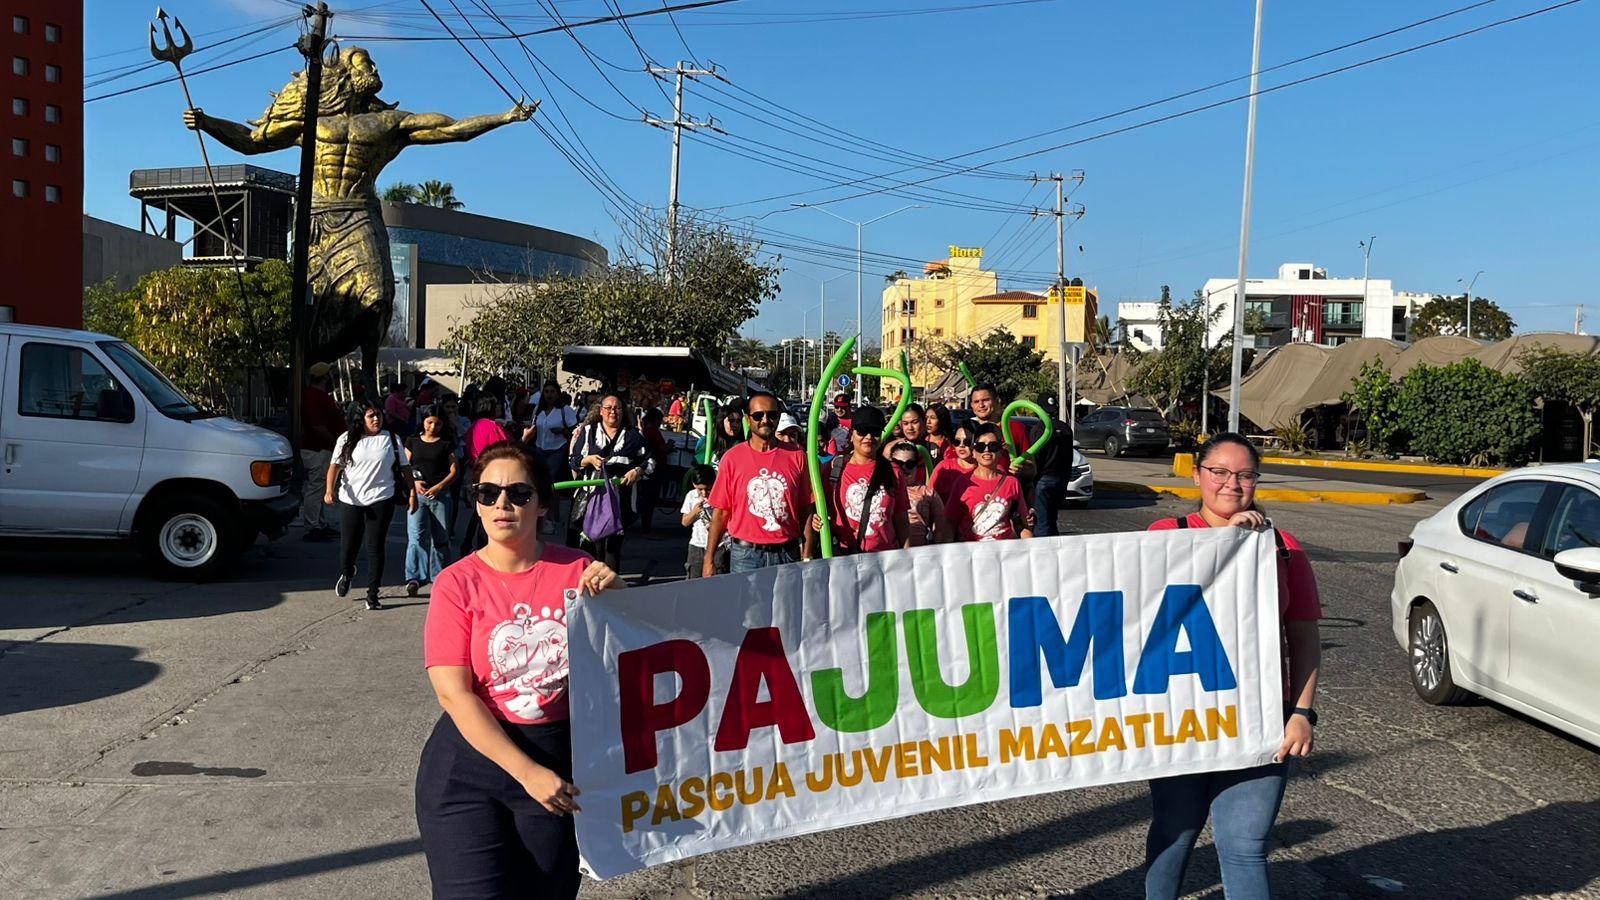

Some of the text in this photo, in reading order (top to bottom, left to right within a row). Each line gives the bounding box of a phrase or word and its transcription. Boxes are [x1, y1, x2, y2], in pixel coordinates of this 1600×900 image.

[949, 245, 983, 257] Hotel
[619, 585, 1236, 774] PAJUMA
[622, 705, 1238, 833] PASCUA JUVENIL MAZATLAN
